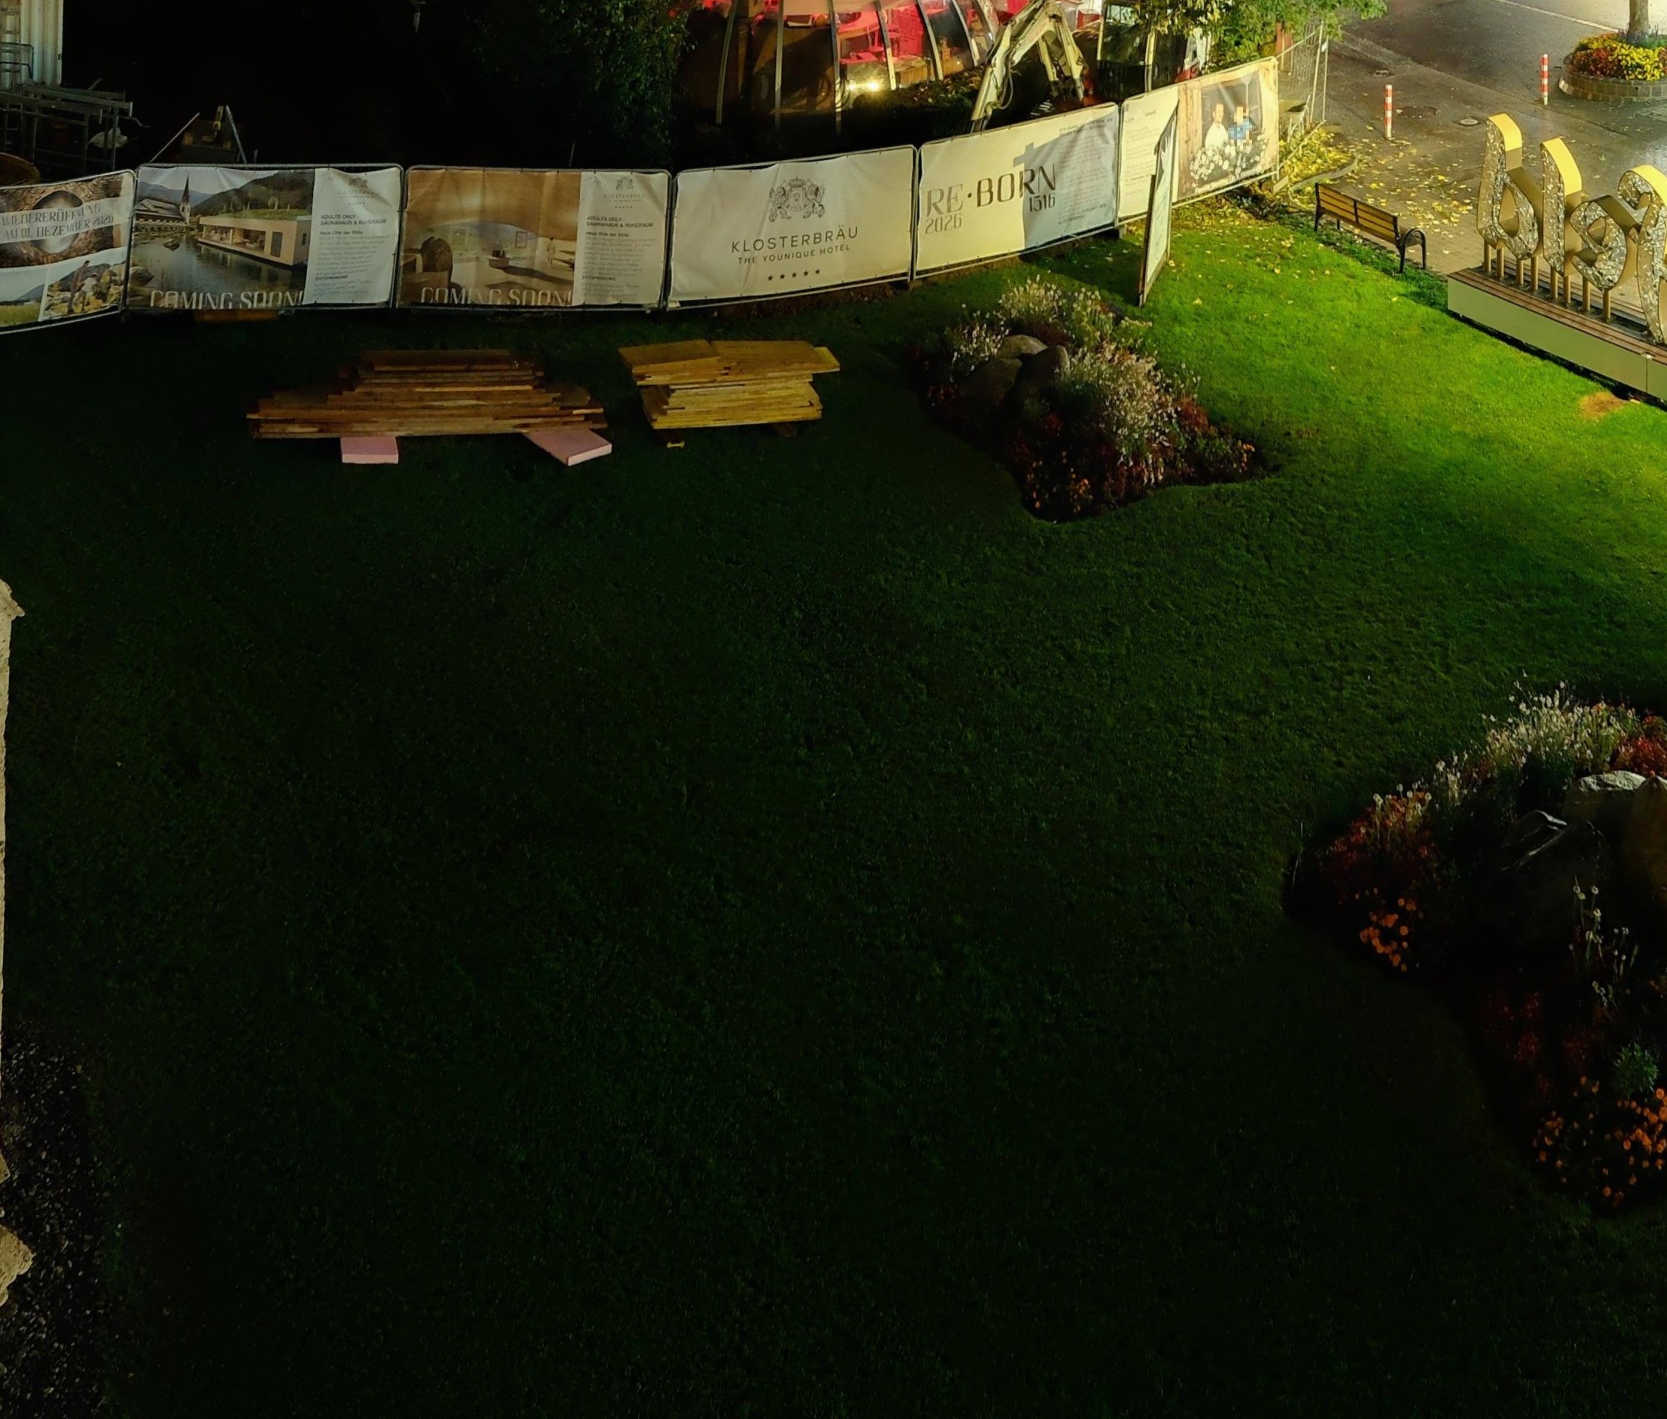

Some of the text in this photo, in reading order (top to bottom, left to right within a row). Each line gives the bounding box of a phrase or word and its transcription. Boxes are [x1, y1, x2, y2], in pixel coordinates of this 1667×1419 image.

[1028, 192, 1056, 213] 1516
[925, 212, 962, 234] 2026
[731, 224, 858, 253] KLOSTERBRÄU
[738, 244, 851, 264] THE YOUNIQUE HOTEL
[150, 290, 305, 309] COMING SOON!
[421, 287, 501, 306] COMING
[507, 287, 573, 306] SOON!
